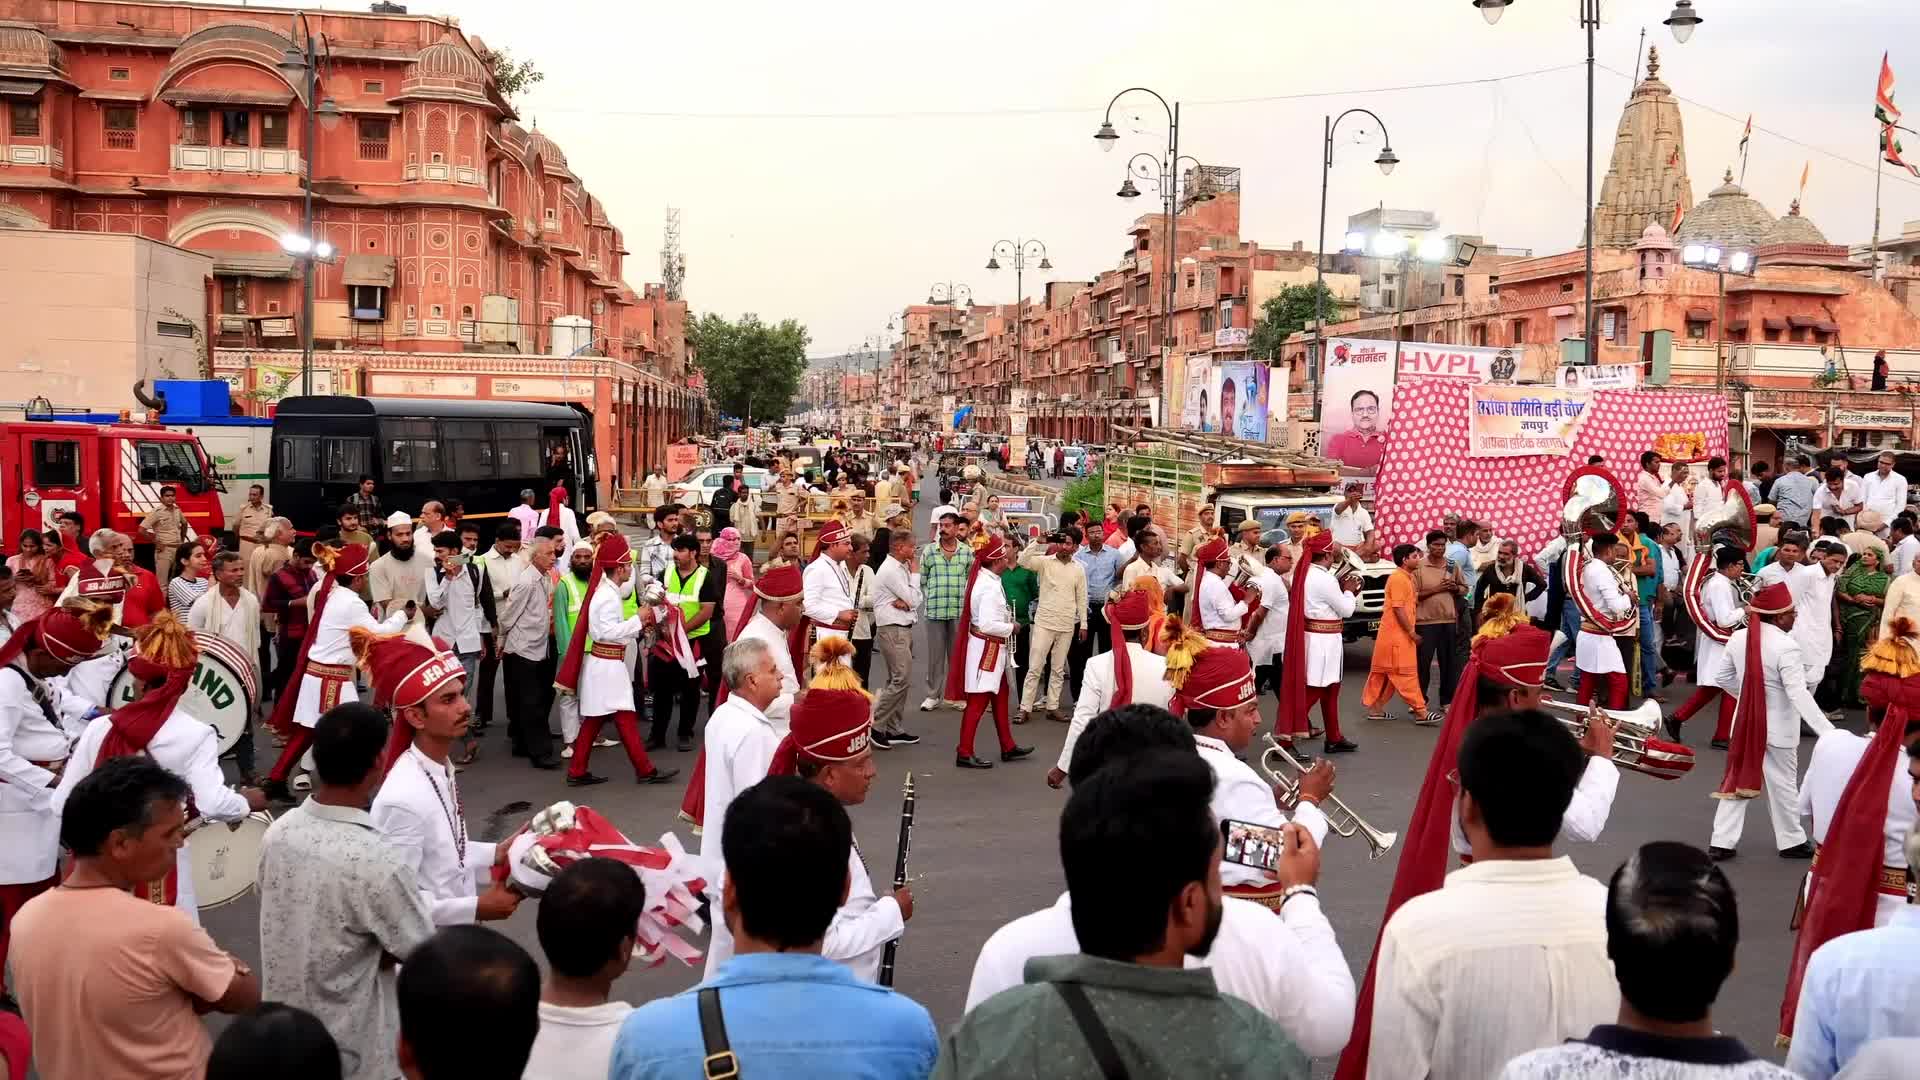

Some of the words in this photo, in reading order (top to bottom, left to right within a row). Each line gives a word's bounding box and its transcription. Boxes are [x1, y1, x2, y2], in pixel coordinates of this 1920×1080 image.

[1351, 352, 1387, 364] हवामहल
[1399, 351, 1480, 374] HVPL
[1511, 398, 1542, 416] समिति
[1520, 421, 1548, 433] जयपुर
